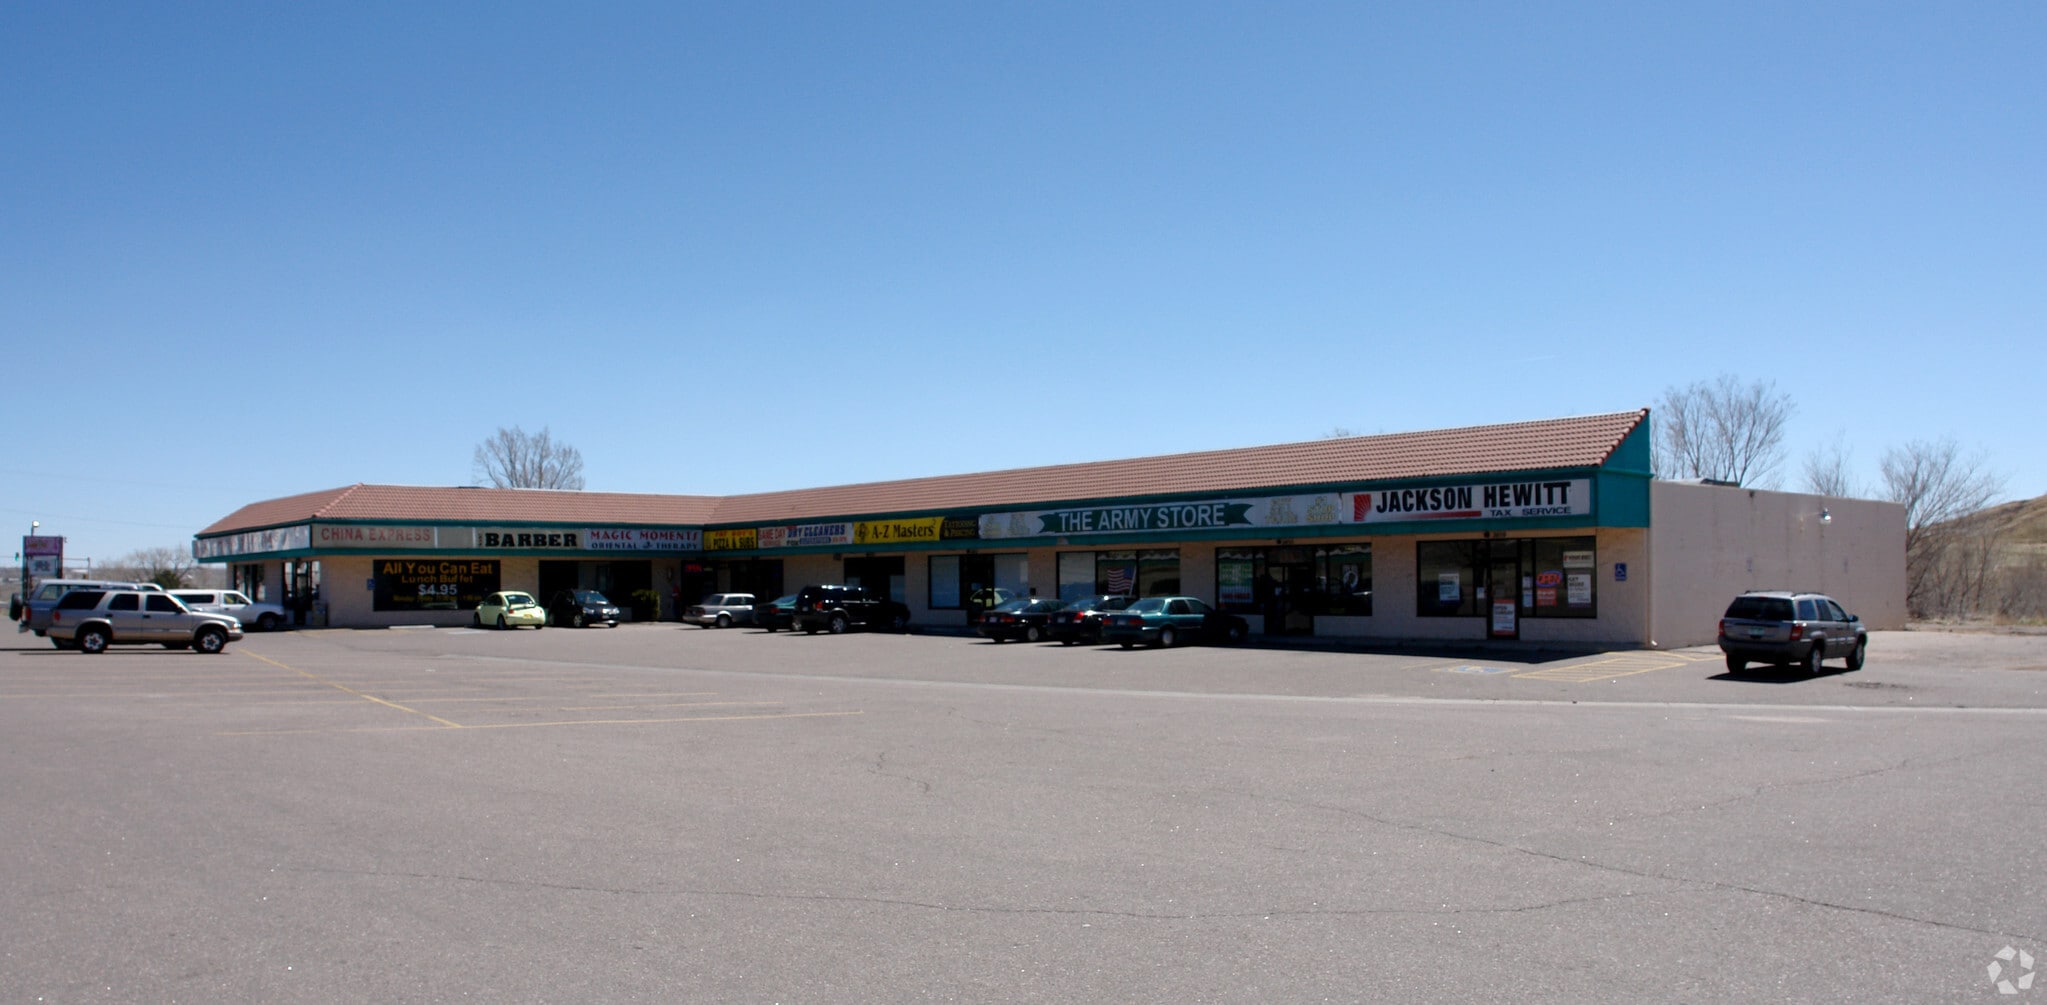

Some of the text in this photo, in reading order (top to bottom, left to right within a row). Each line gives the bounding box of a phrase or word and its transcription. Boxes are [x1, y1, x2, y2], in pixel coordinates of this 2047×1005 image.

[1376, 481, 1571, 513] JACKSON HEWITT
[1059, 504, 1226, 531] THE ARMY STORE
[1522, 506, 1572, 516] SERVICE
[321, 528, 431, 541] CHINA EXPRESS
[591, 530, 698, 541] MAGIC MOMENTS
[804, 524, 845, 537] CLEANERS
[872, 523, 934, 539] A-Z Masters
[486, 533, 577, 547] BARBER
[656, 542, 698, 550] THERAPY
[383, 562, 493, 575] All You Can Eat
[401, 575, 437, 584] Lunch
[418, 584, 458, 596] $4.95
